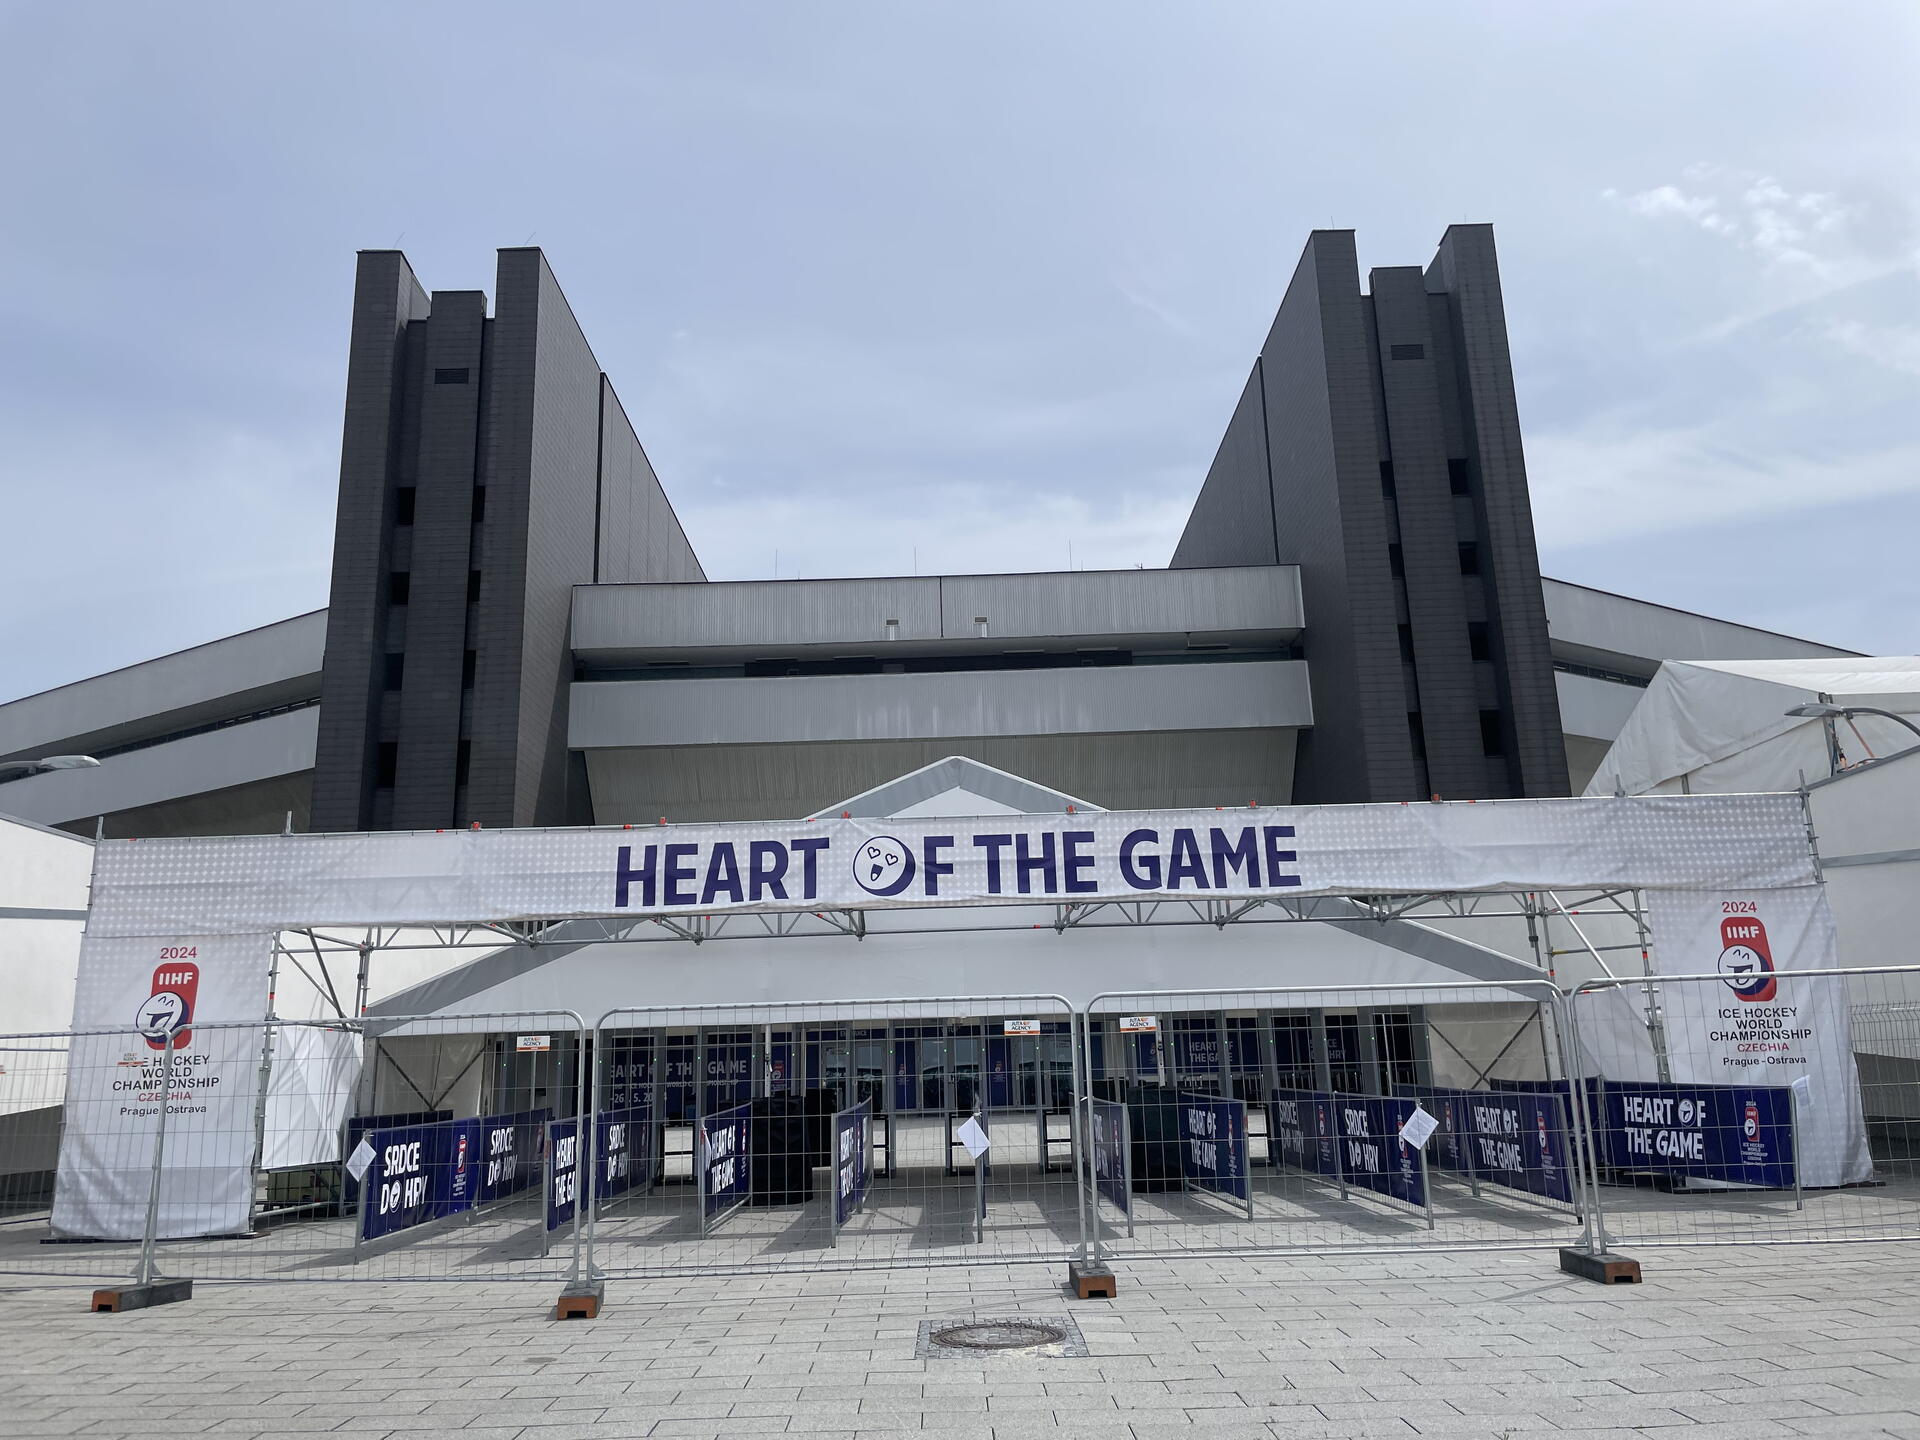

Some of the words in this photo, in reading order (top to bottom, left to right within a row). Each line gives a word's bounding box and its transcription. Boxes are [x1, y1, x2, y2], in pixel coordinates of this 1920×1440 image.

[614, 837, 830, 908] HEART
[973, 831, 1098, 894] THE
[1119, 826, 1302, 890] GAME
[1722, 901, 1757, 913] 2024
[1726, 926, 1760, 939] IIHF
[160, 947, 197, 959] 2024
[158, 972, 194, 985] IIHF
[1718, 1008, 1741, 1019] ICE
[1745, 1007, 1798, 1018] HOCKEY
[1736, 1018, 1782, 1030] WORLD
[1710, 1028, 1812, 1041] CHAMPIONSHIP
[1189, 1041, 1218, 1051] HEART
[1737, 1043, 1789, 1052] CZECHIA
[153, 1055, 210, 1066] HCKEY
[708, 1060, 747, 1074] GAME
[1723, 1057, 1760, 1067] Prague
[1767, 1056, 1807, 1065] Ostrava
[112, 1077, 219, 1091] CHAMPONSHIP
[120, 1107, 159, 1117] Prague
[166, 1105, 207, 1114] Ostrava
[1623, 1096, 1674, 1125] HEART
[1344, 1108, 1369, 1137] SRDCE
[1474, 1105, 1501, 1135] HEART
[490, 1126, 514, 1156] SRDCE
[1624, 1127, 1653, 1155] THE
[1656, 1129, 1703, 1160] GAME
[383, 1141, 420, 1177] SRDCE
[556, 1135, 575, 1170] HEART
[1362, 1143, 1379, 1173] HRY
[1479, 1138, 1497, 1167] THE
[1497, 1140, 1523, 1173] GAME
[502, 1154, 518, 1181] HRY
[404, 1175, 428, 1208] HRY
